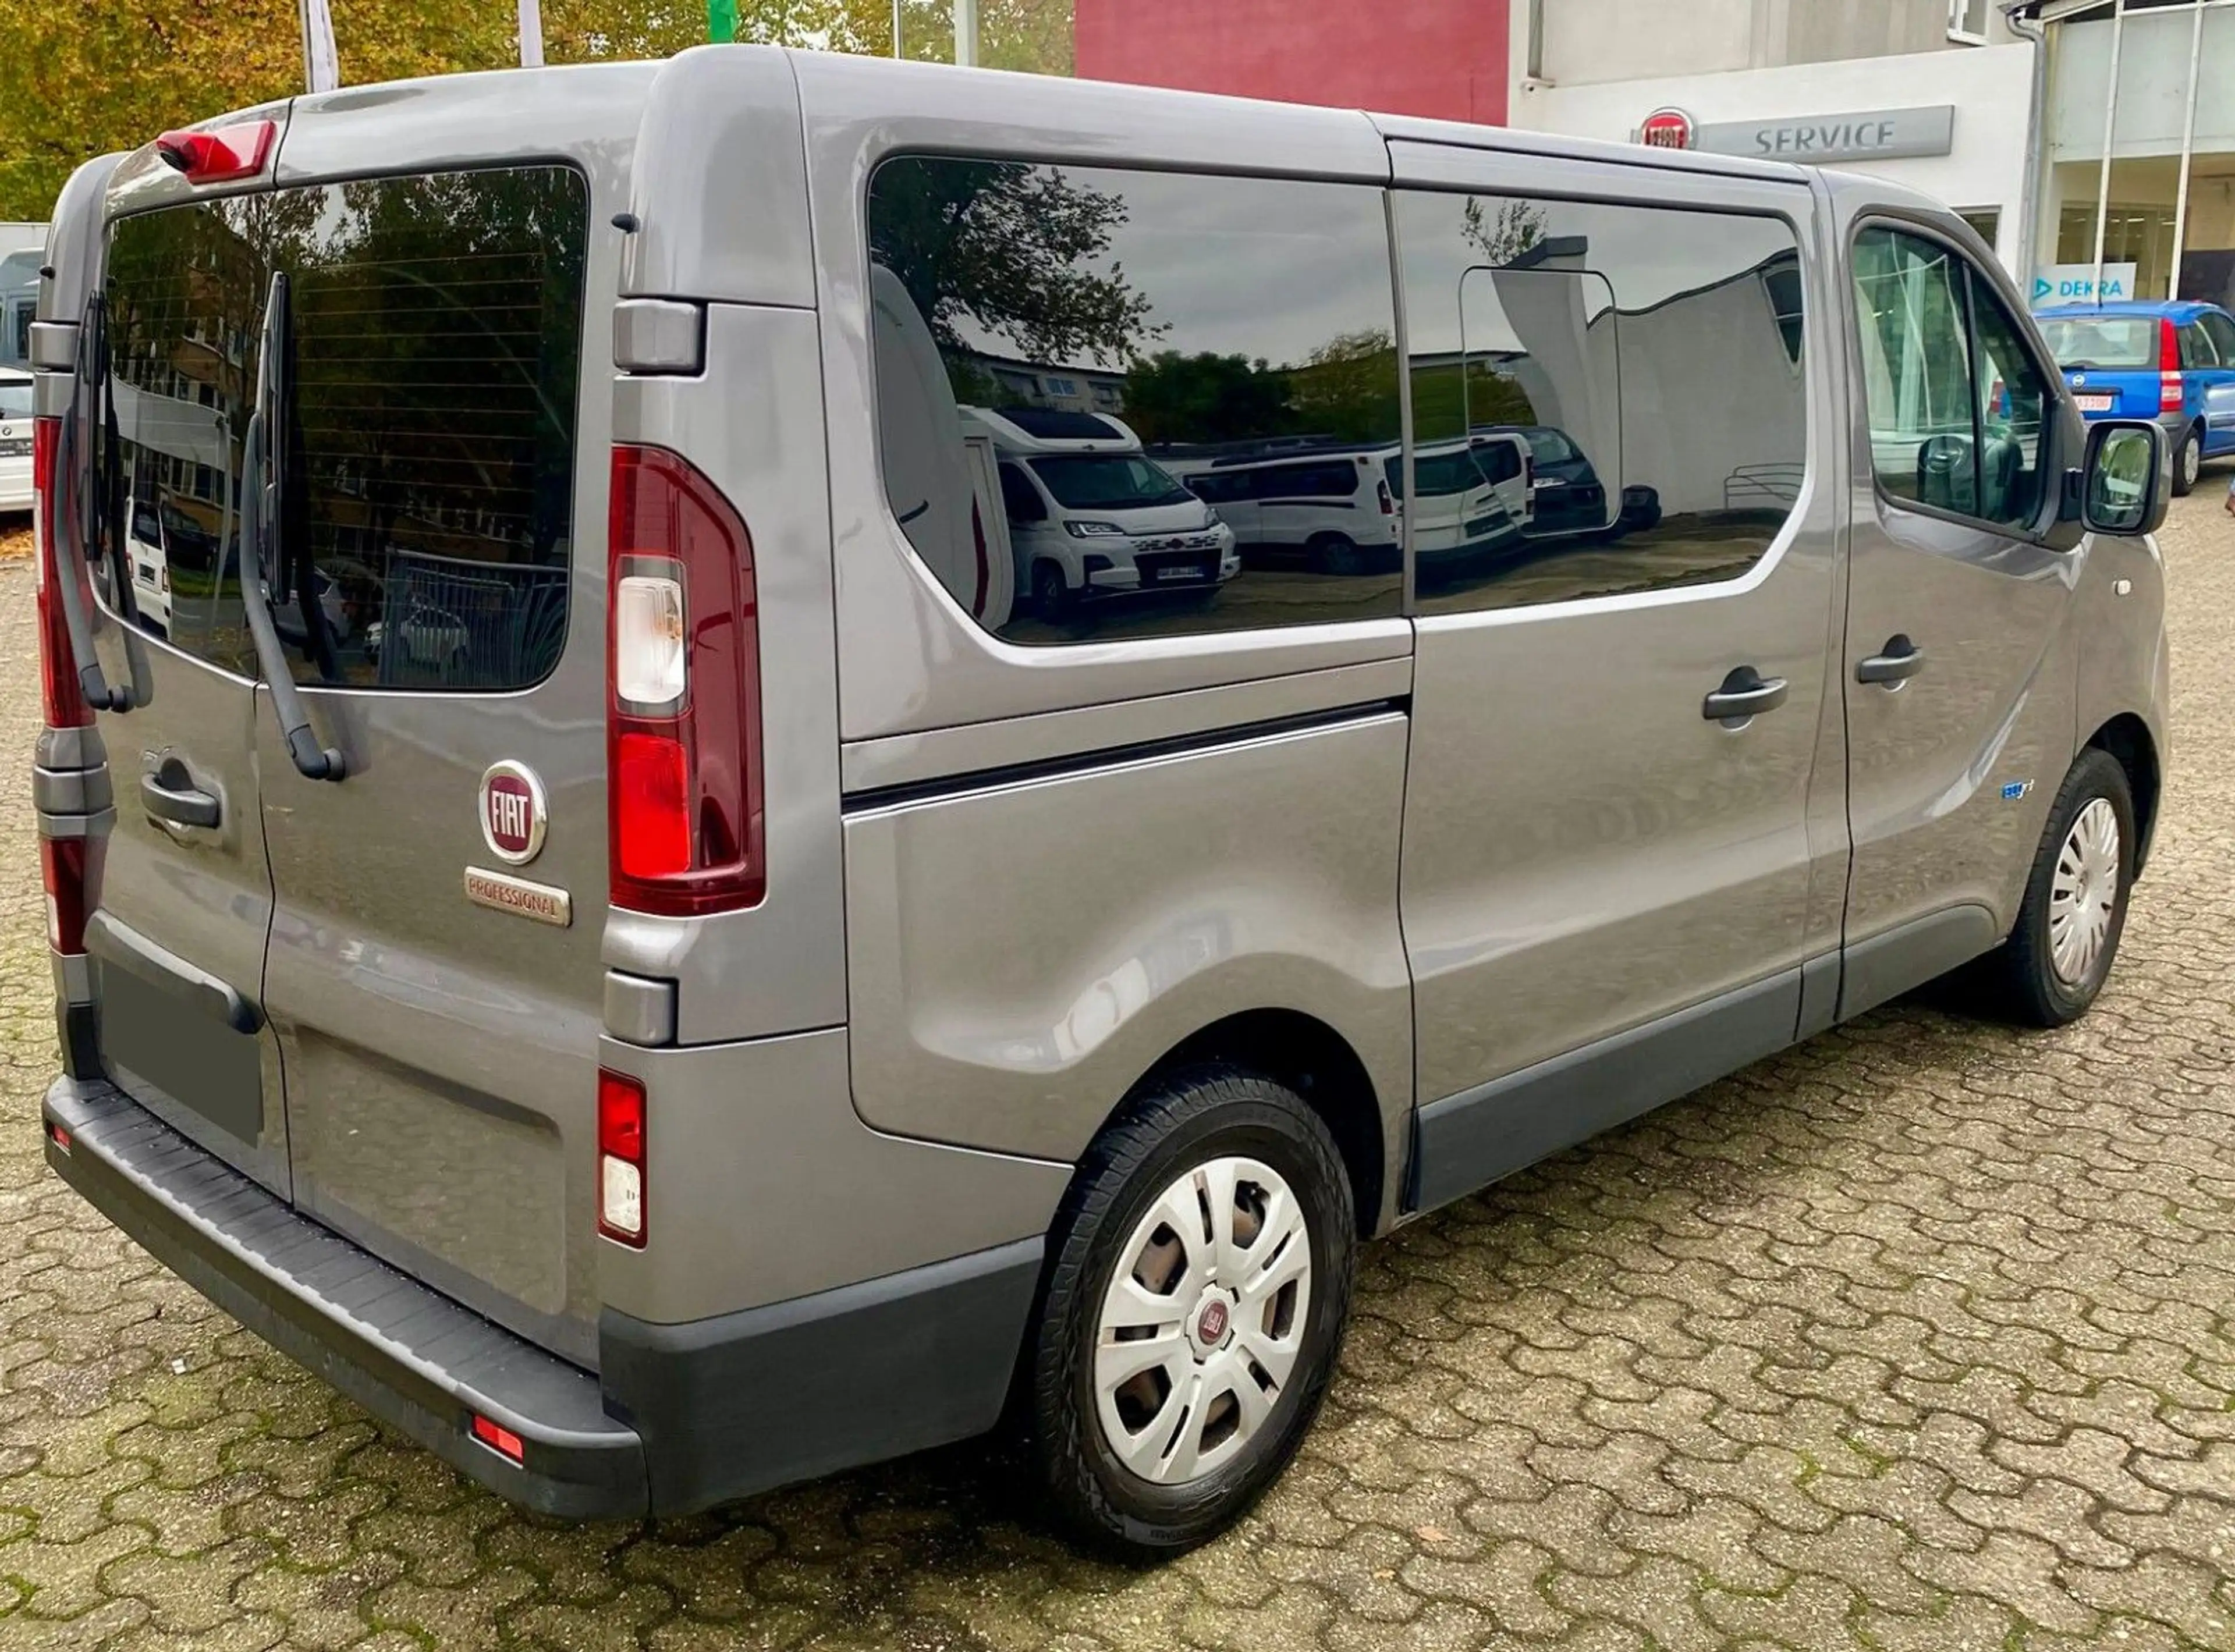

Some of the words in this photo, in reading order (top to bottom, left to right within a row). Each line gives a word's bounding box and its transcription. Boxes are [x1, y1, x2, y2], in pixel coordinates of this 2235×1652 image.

[1755, 121, 1895, 154] SERVICE
[491, 790, 528, 839] FIAT
[469, 877, 559, 916] PROFESSIONAL
